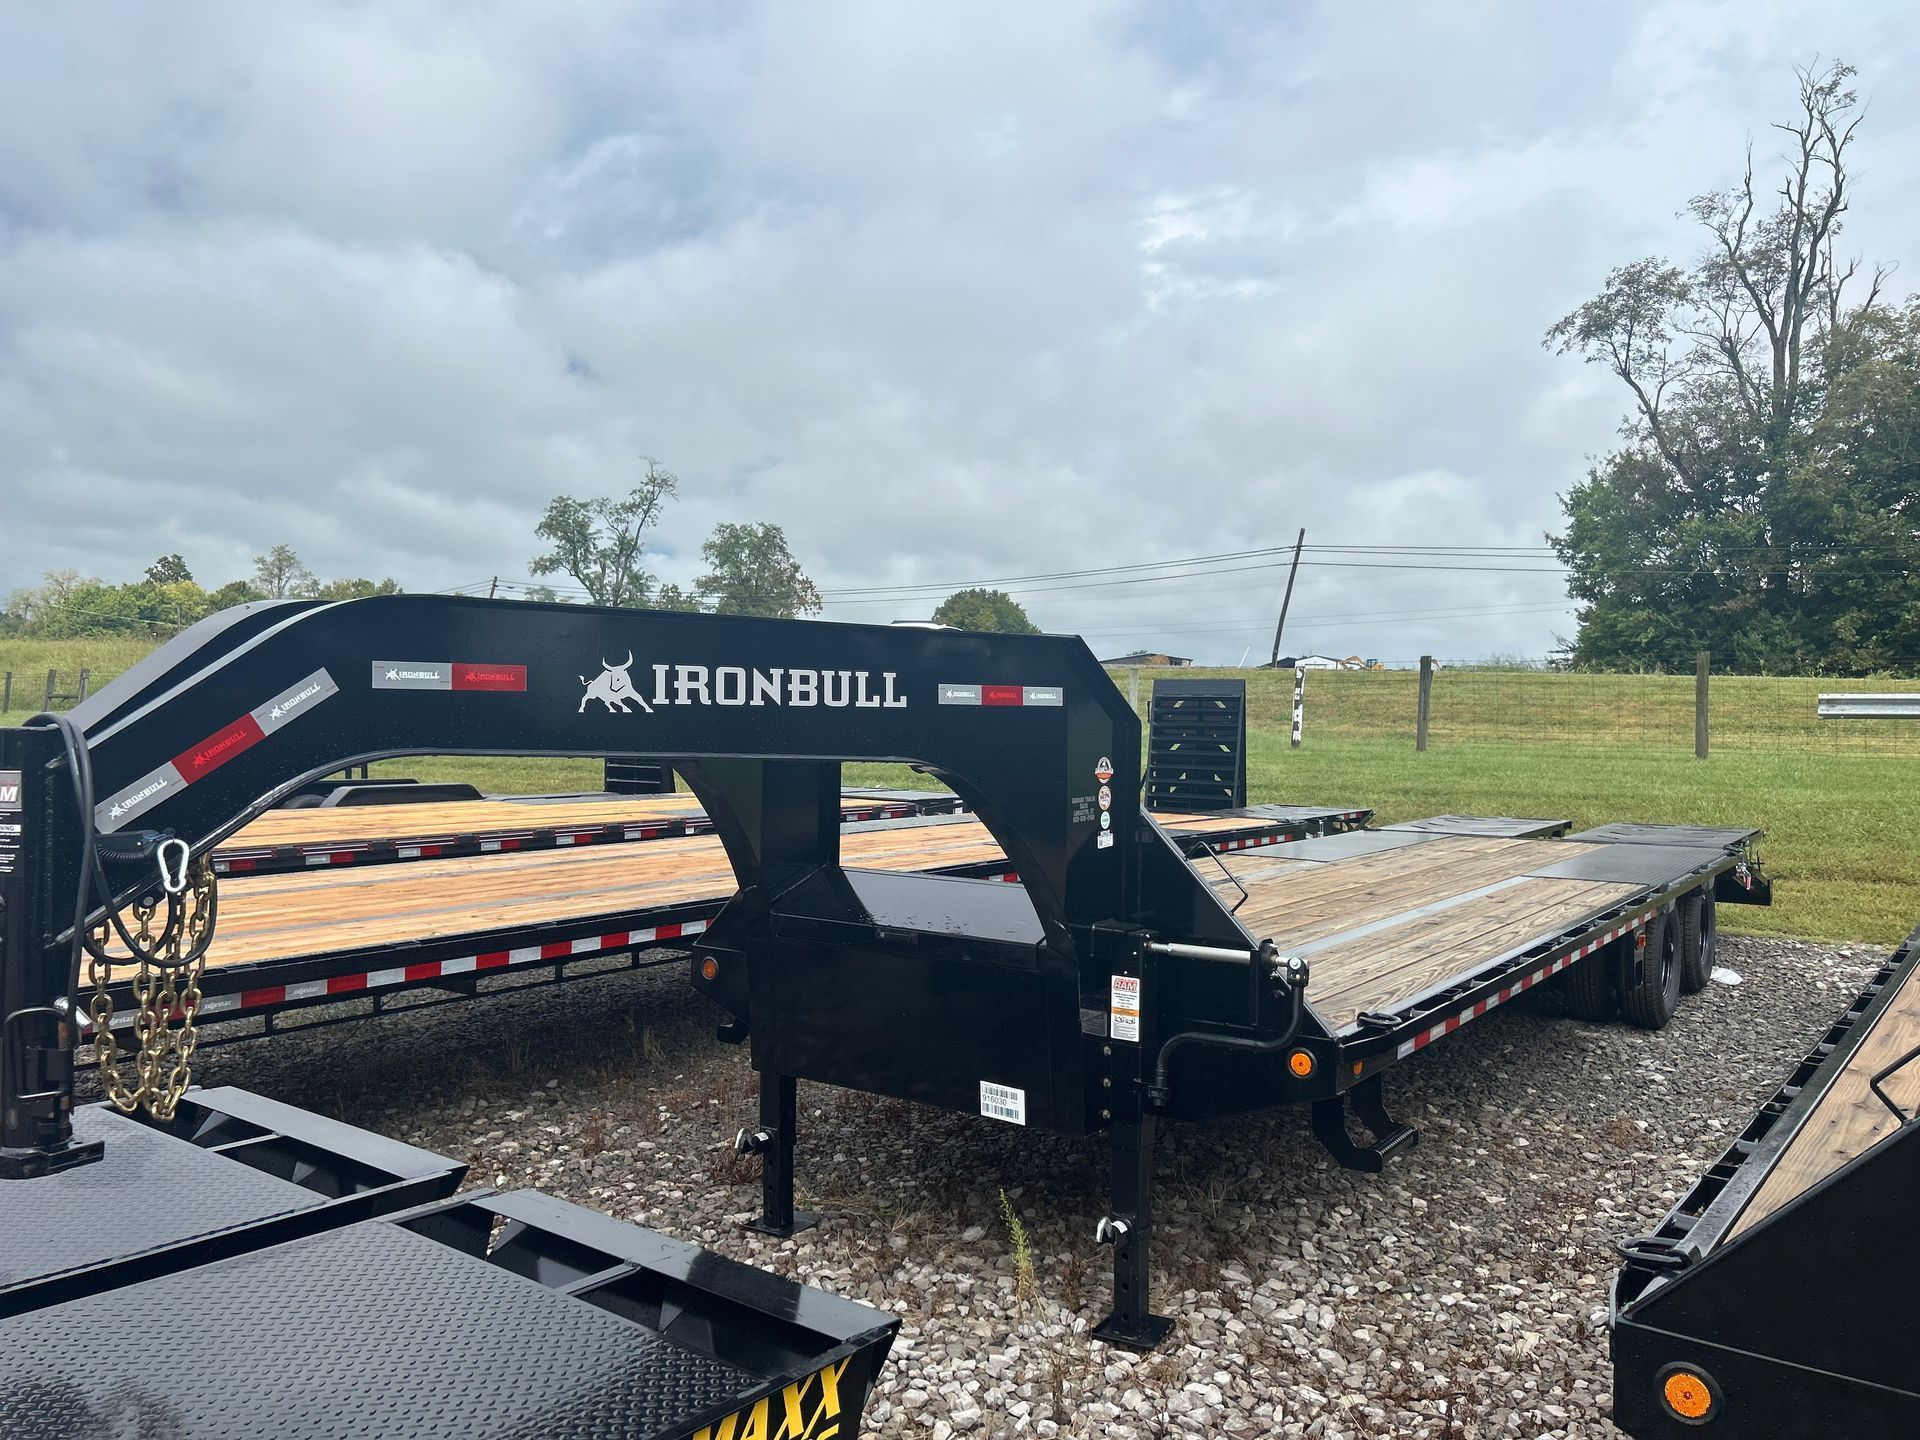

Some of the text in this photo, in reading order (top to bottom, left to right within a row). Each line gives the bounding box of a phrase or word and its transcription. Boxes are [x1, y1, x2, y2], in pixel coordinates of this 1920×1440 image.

[399, 670, 441, 681] IRONBULL
[652, 664, 907, 708] IRONBULL
[281, 682, 321, 712] IRONBULL
[123, 777, 168, 810] IRONBULL
[982, 1093, 1008, 1107] 916030
